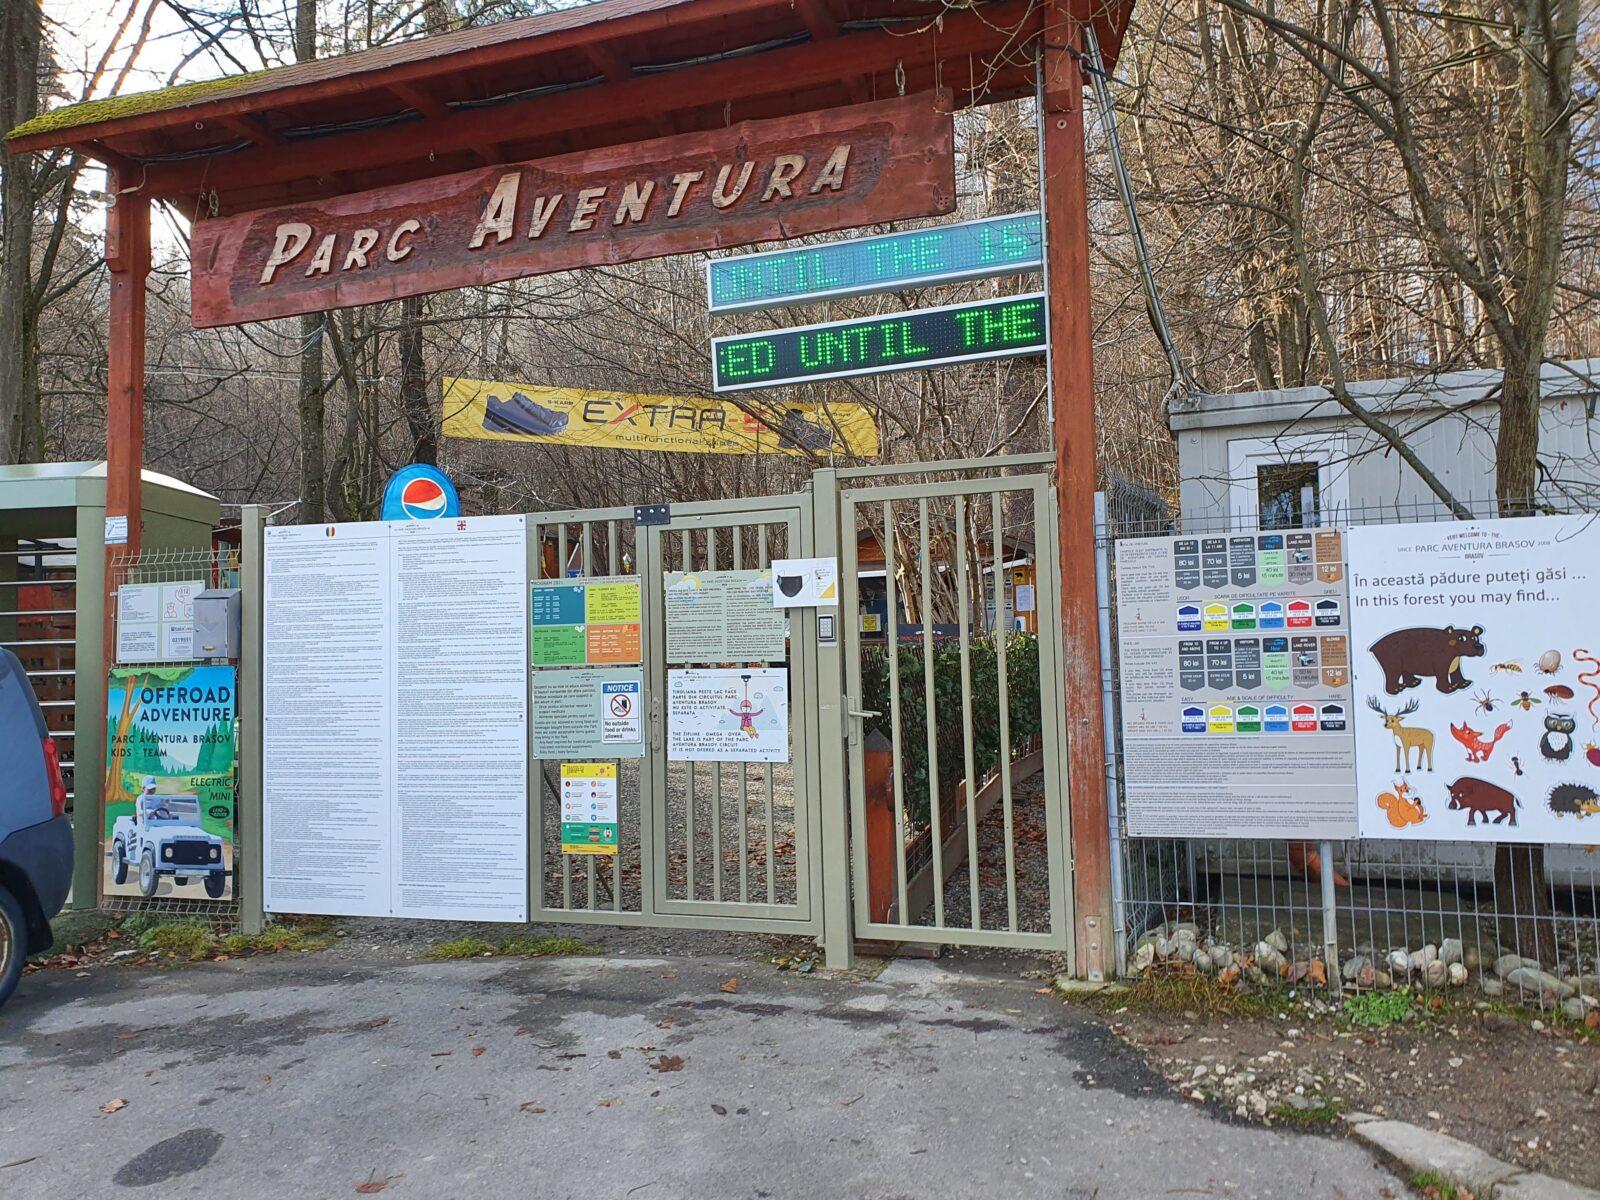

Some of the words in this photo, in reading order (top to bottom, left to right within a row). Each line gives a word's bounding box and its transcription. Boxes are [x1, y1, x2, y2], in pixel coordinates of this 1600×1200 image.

[259, 218, 421, 285] PARC
[467, 144, 852, 250] AVENTURA
[715, 253, 838, 300] UNTIL
[866, 234, 945, 275] THE
[979, 221, 1041, 260] 15
[720, 341, 776, 377] ED
[800, 321, 930, 369] UNTIL
[955, 303, 1041, 346] THE
[1441, 542, 1492, 552] AVENTURA
[1495, 540, 1536, 550] BRASOV
[1353, 573, 1367, 588] În
[1372, 573, 1425, 587] această
[1430, 571, 1481, 587] pădure
[1536, 567, 1567, 584] găsi
[1356, 595, 1368, 607] In
[1373, 594, 1399, 606] this
[1404, 592, 1445, 606] forest
[1449, 592, 1476, 608] you
[1481, 590, 1512, 606] may
[141, 686, 230, 704] OFFROAD
[607, 684, 634, 692] NOTICE
[140, 708, 230, 722] ADVENTURE
[112, 735, 134, 744] PARC
[140, 735, 188, 744] AVENTURA
[193, 734, 231, 744] BRASOV
[112, 748, 132, 757] KIDS
[144, 748, 168, 757] TEAM
[190, 778, 231, 786] ELECTRIC
